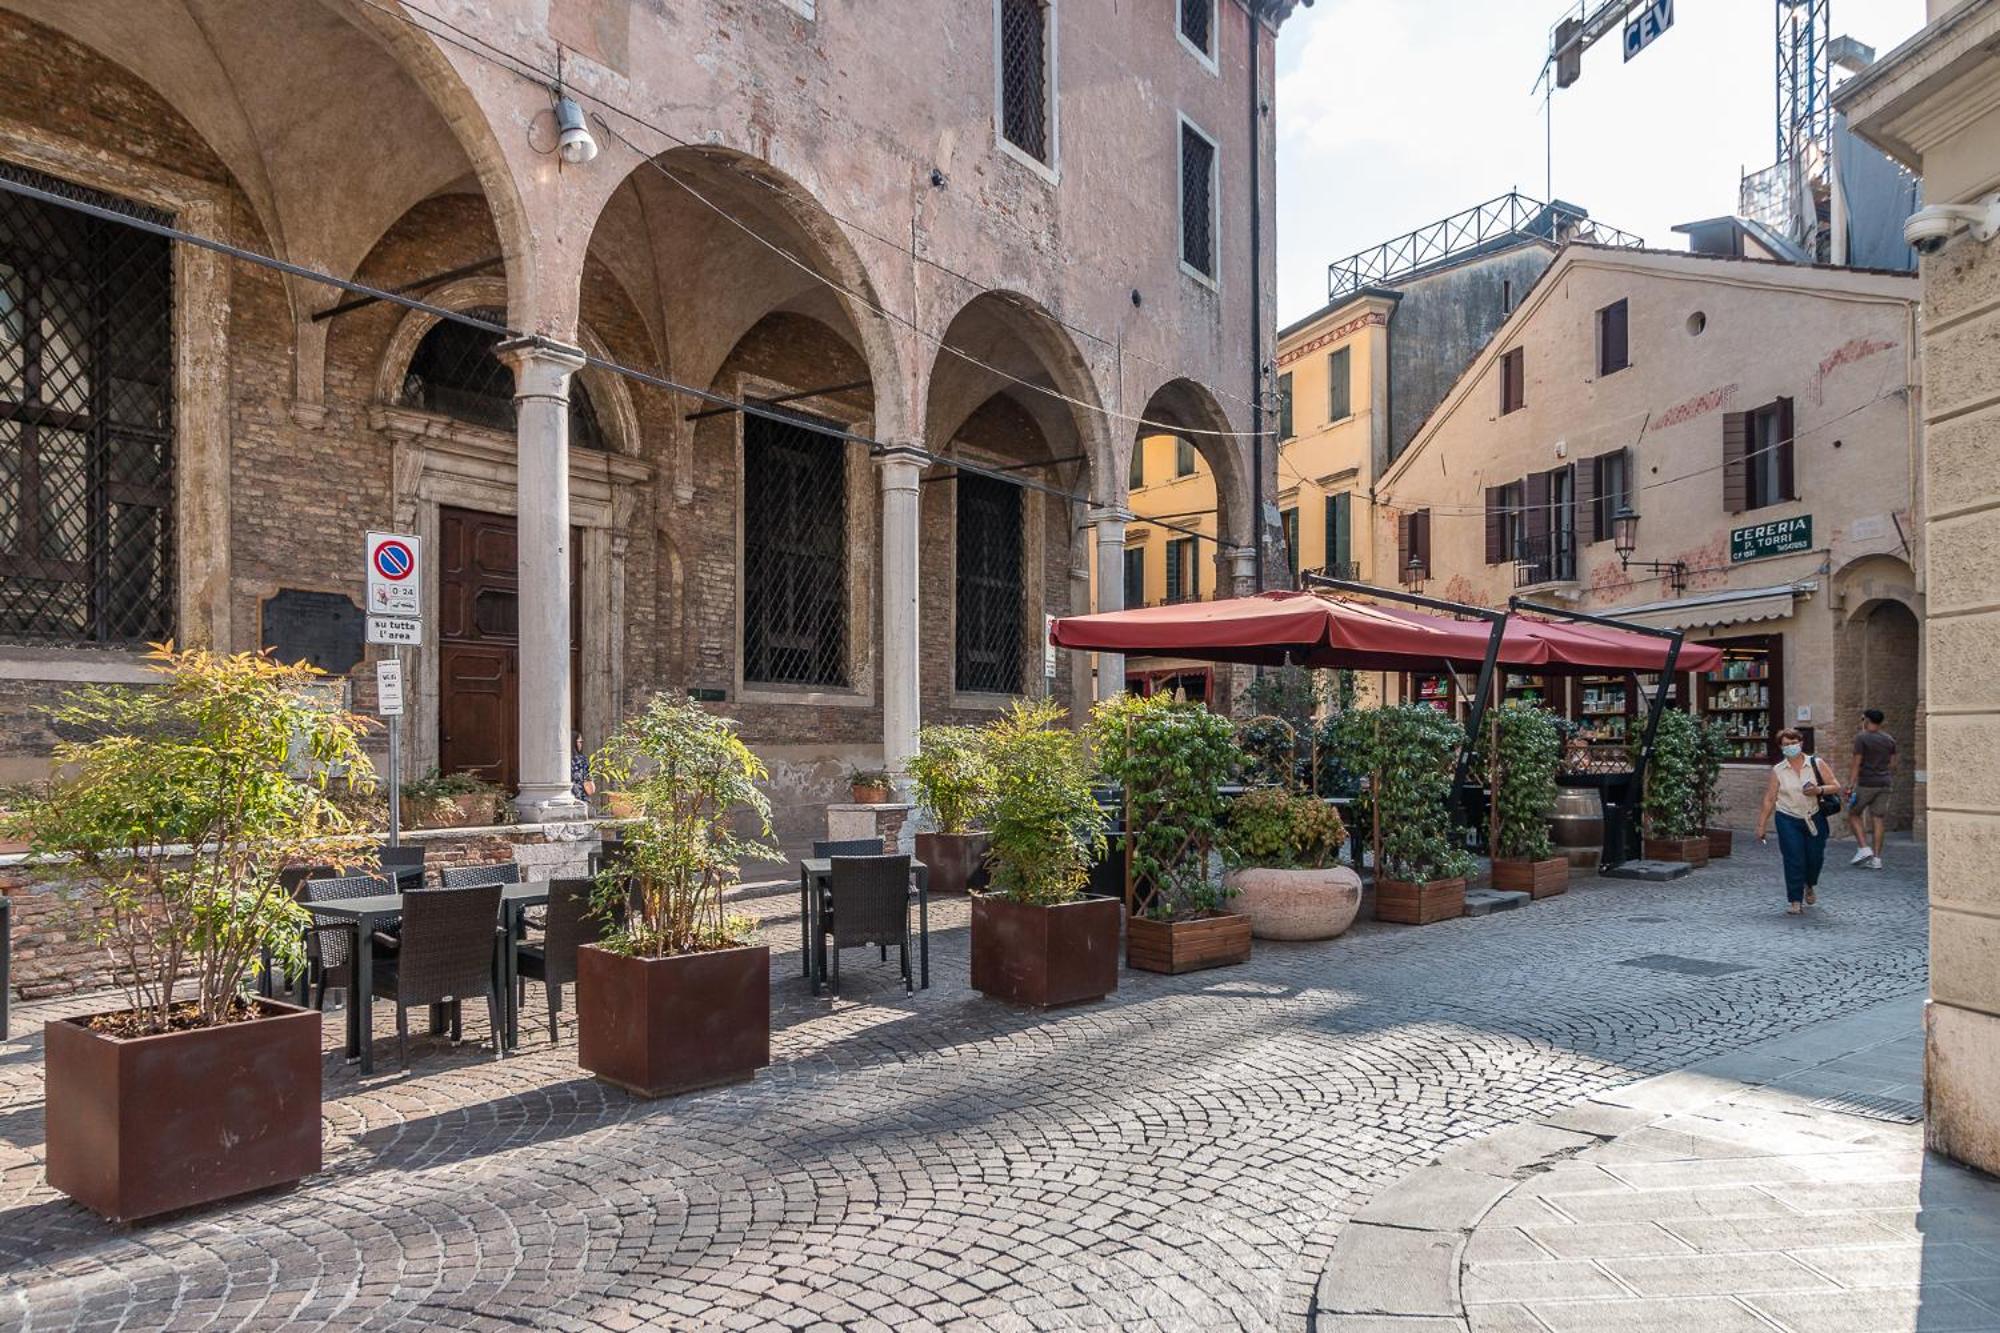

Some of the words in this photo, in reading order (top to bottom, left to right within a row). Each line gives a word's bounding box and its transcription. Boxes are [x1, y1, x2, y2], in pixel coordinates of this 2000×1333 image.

[1625, 0, 1672, 57] CEV
[1734, 519, 1806, 542] CERERIA
[1744, 541, 1754, 550] P.
[1758, 533, 1792, 548] TORRI
[390, 621, 415, 630] tutta
